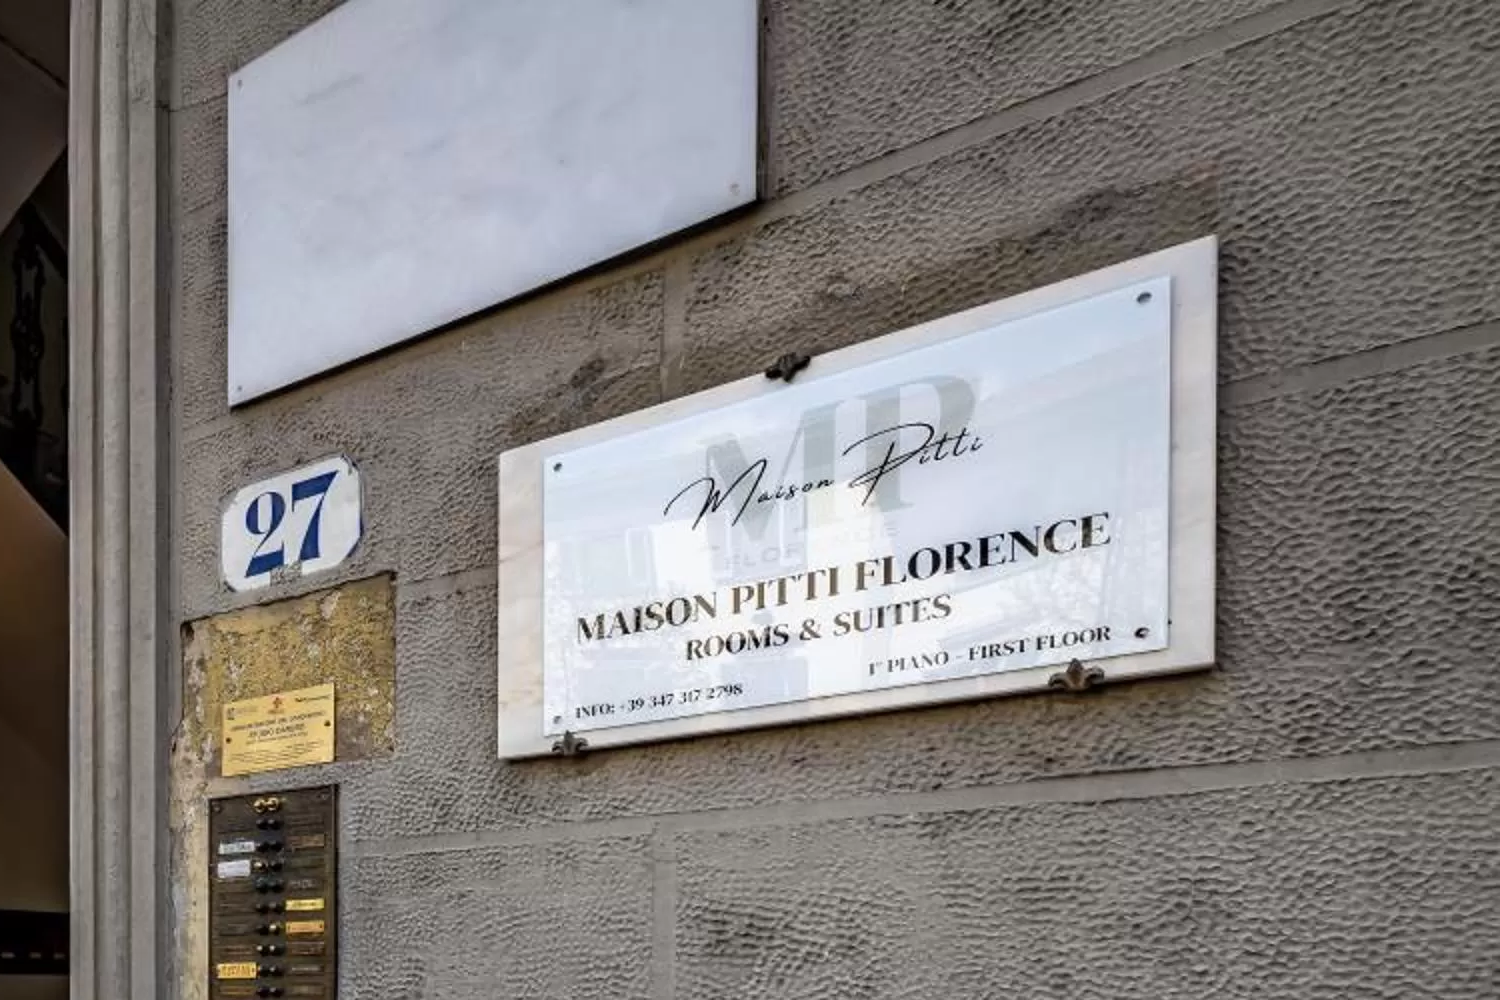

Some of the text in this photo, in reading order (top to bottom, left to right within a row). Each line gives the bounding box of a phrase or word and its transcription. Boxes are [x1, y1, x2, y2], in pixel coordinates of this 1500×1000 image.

[663, 422, 984, 531] Maison Pitti
[244, 469, 340, 578] 27
[576, 511, 1112, 644] MAISON PITTI FLORENCE
[685, 593, 951, 661] ROOMS & SUITES
[887, 651, 949, 672] PIANO
[969, 638, 1032, 661] FIRST
[1035, 625, 1111, 651] FLOOR
[575, 704, 615, 719] INFO:
[649, 693, 675, 709] 347
[705, 683, 744, 700] 2798
